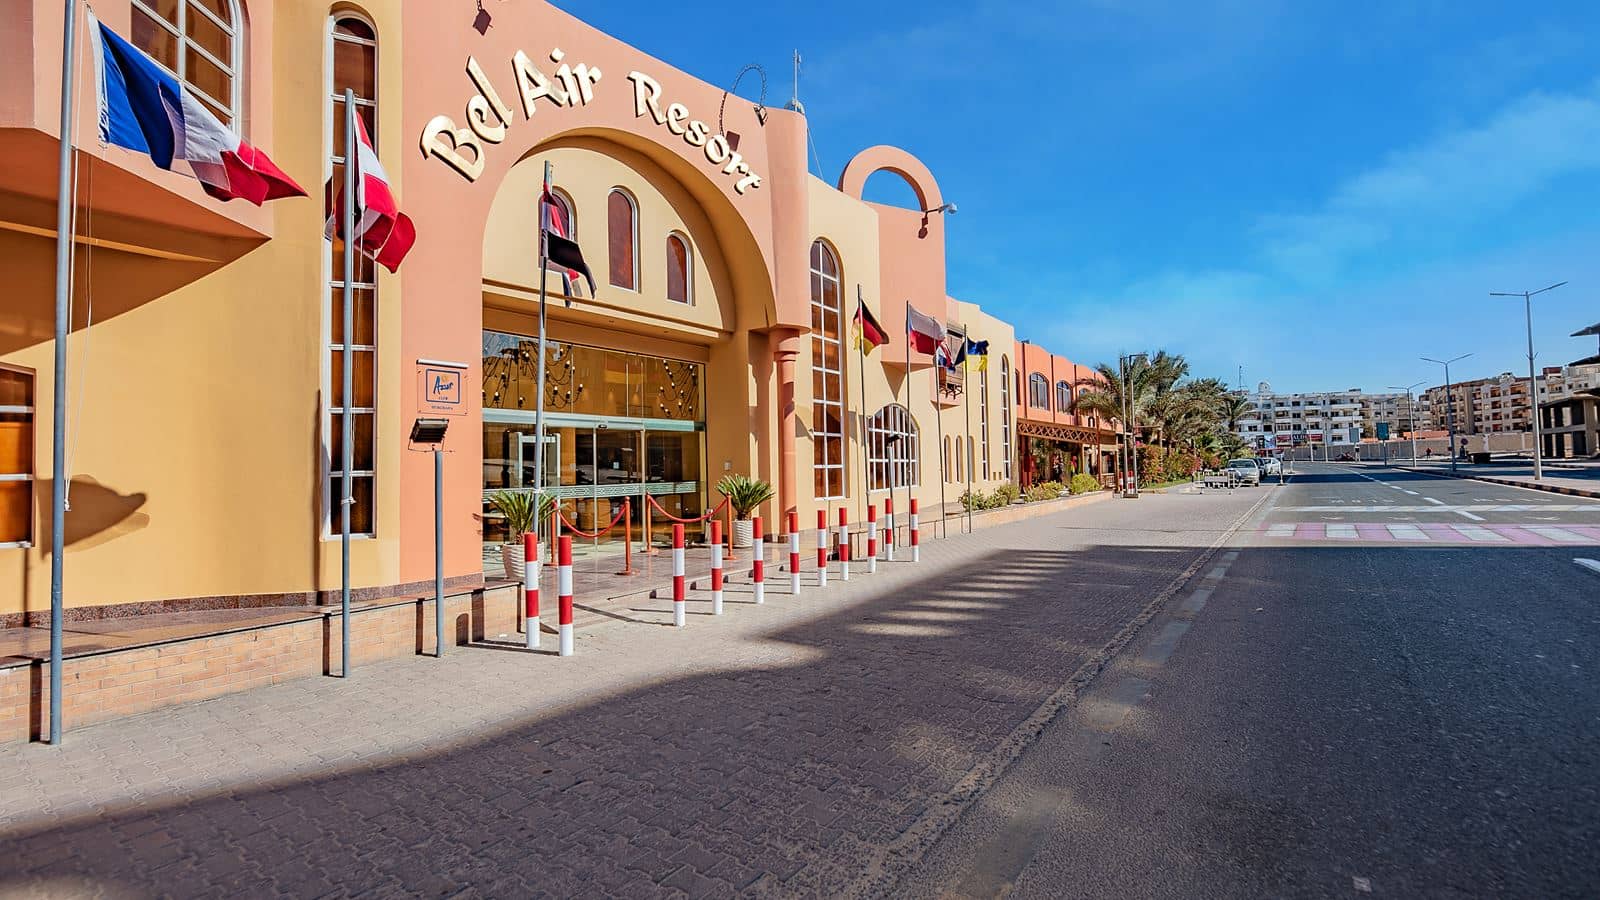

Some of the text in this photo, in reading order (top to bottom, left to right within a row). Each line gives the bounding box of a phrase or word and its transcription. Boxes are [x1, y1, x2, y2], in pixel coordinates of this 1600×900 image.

[420, 47, 762, 195] Bel Air Resort
